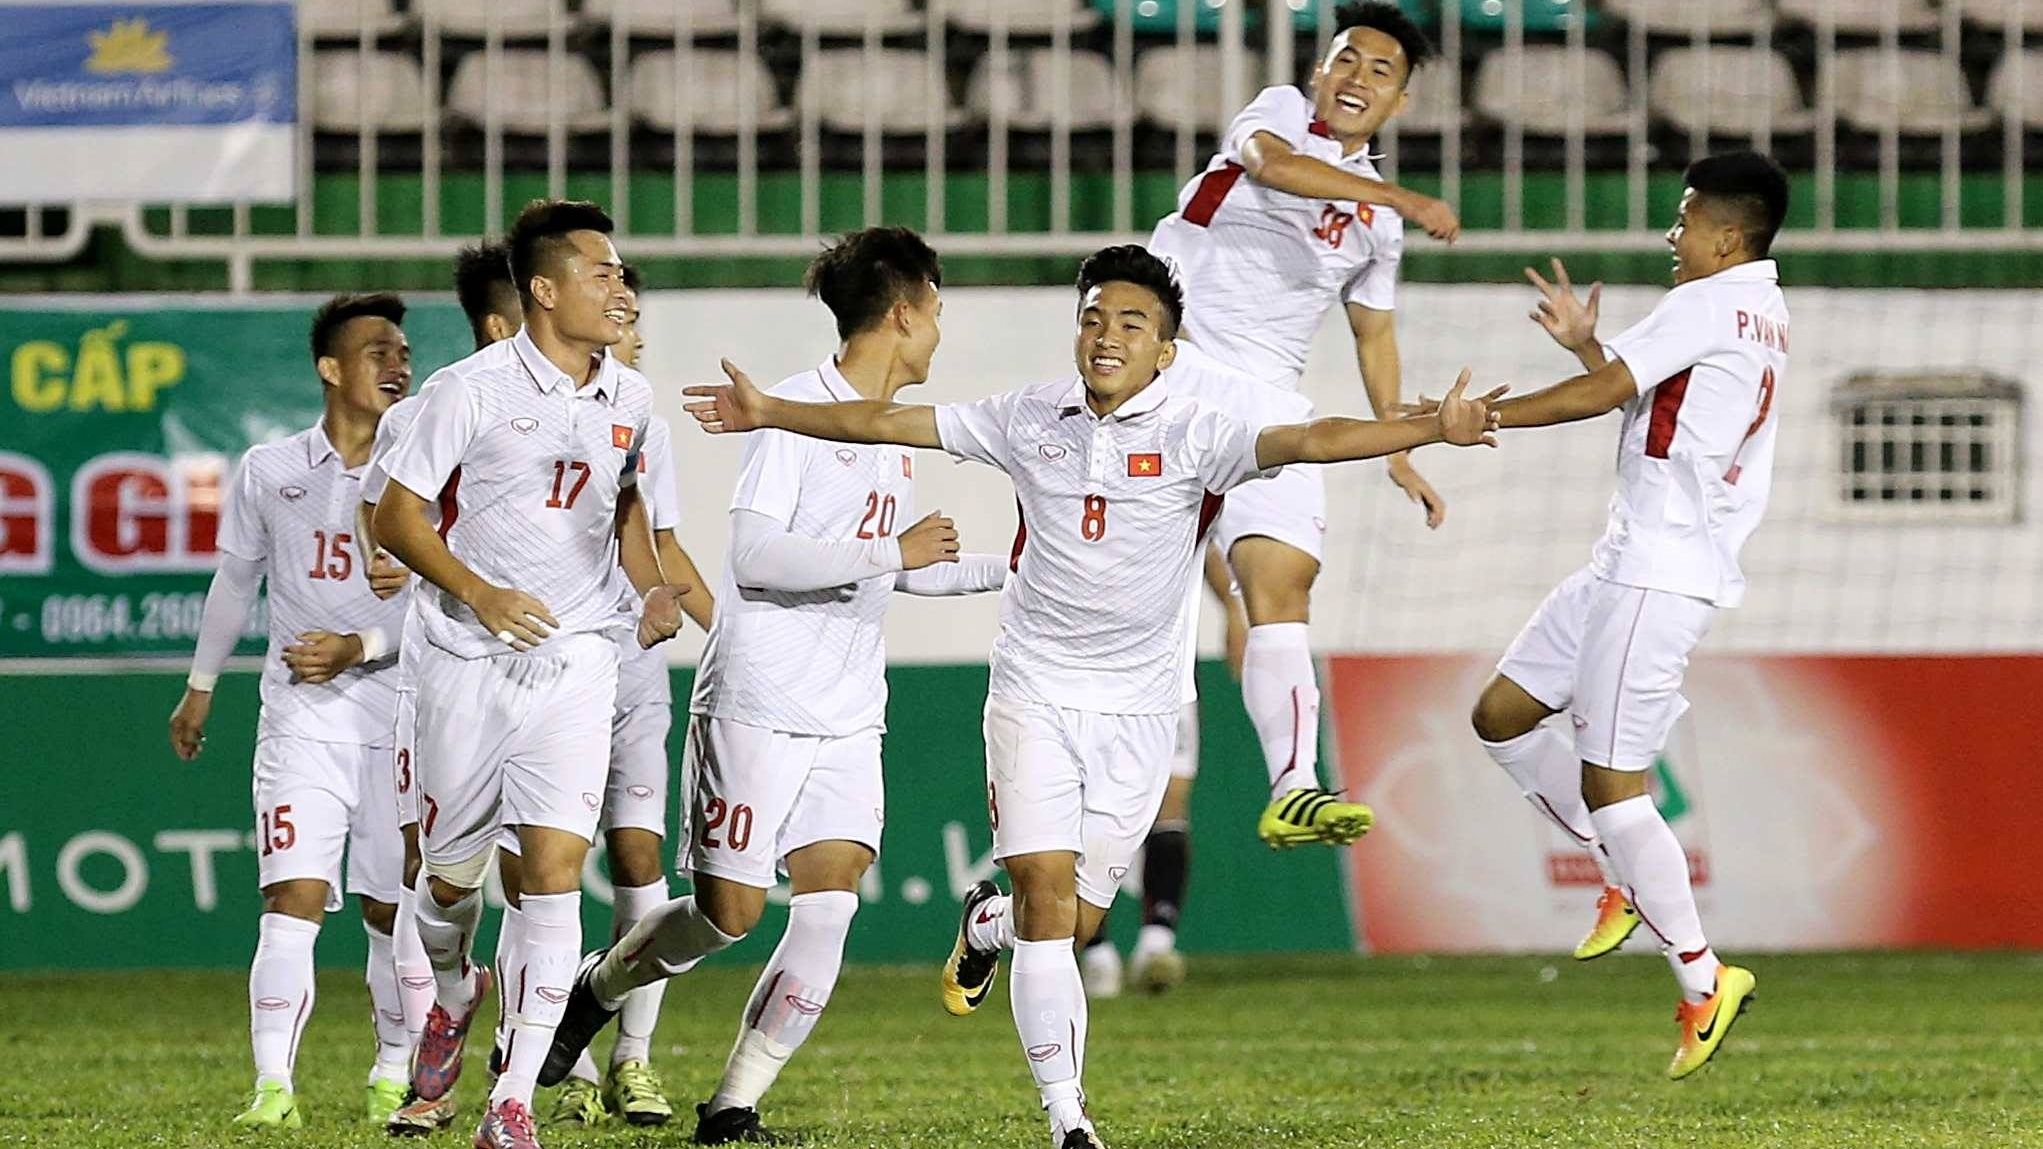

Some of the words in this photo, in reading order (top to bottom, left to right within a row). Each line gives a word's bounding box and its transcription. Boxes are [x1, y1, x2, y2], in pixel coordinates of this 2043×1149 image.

[11, 319, 184, 411] CẤP
[545, 461, 592, 509] 17
[856, 490, 896, 540] 20
[1081, 494, 1107, 541] 8
[309, 531, 352, 581] 15
[262, 805, 295, 857] 15
[701, 797, 752, 851] 20
